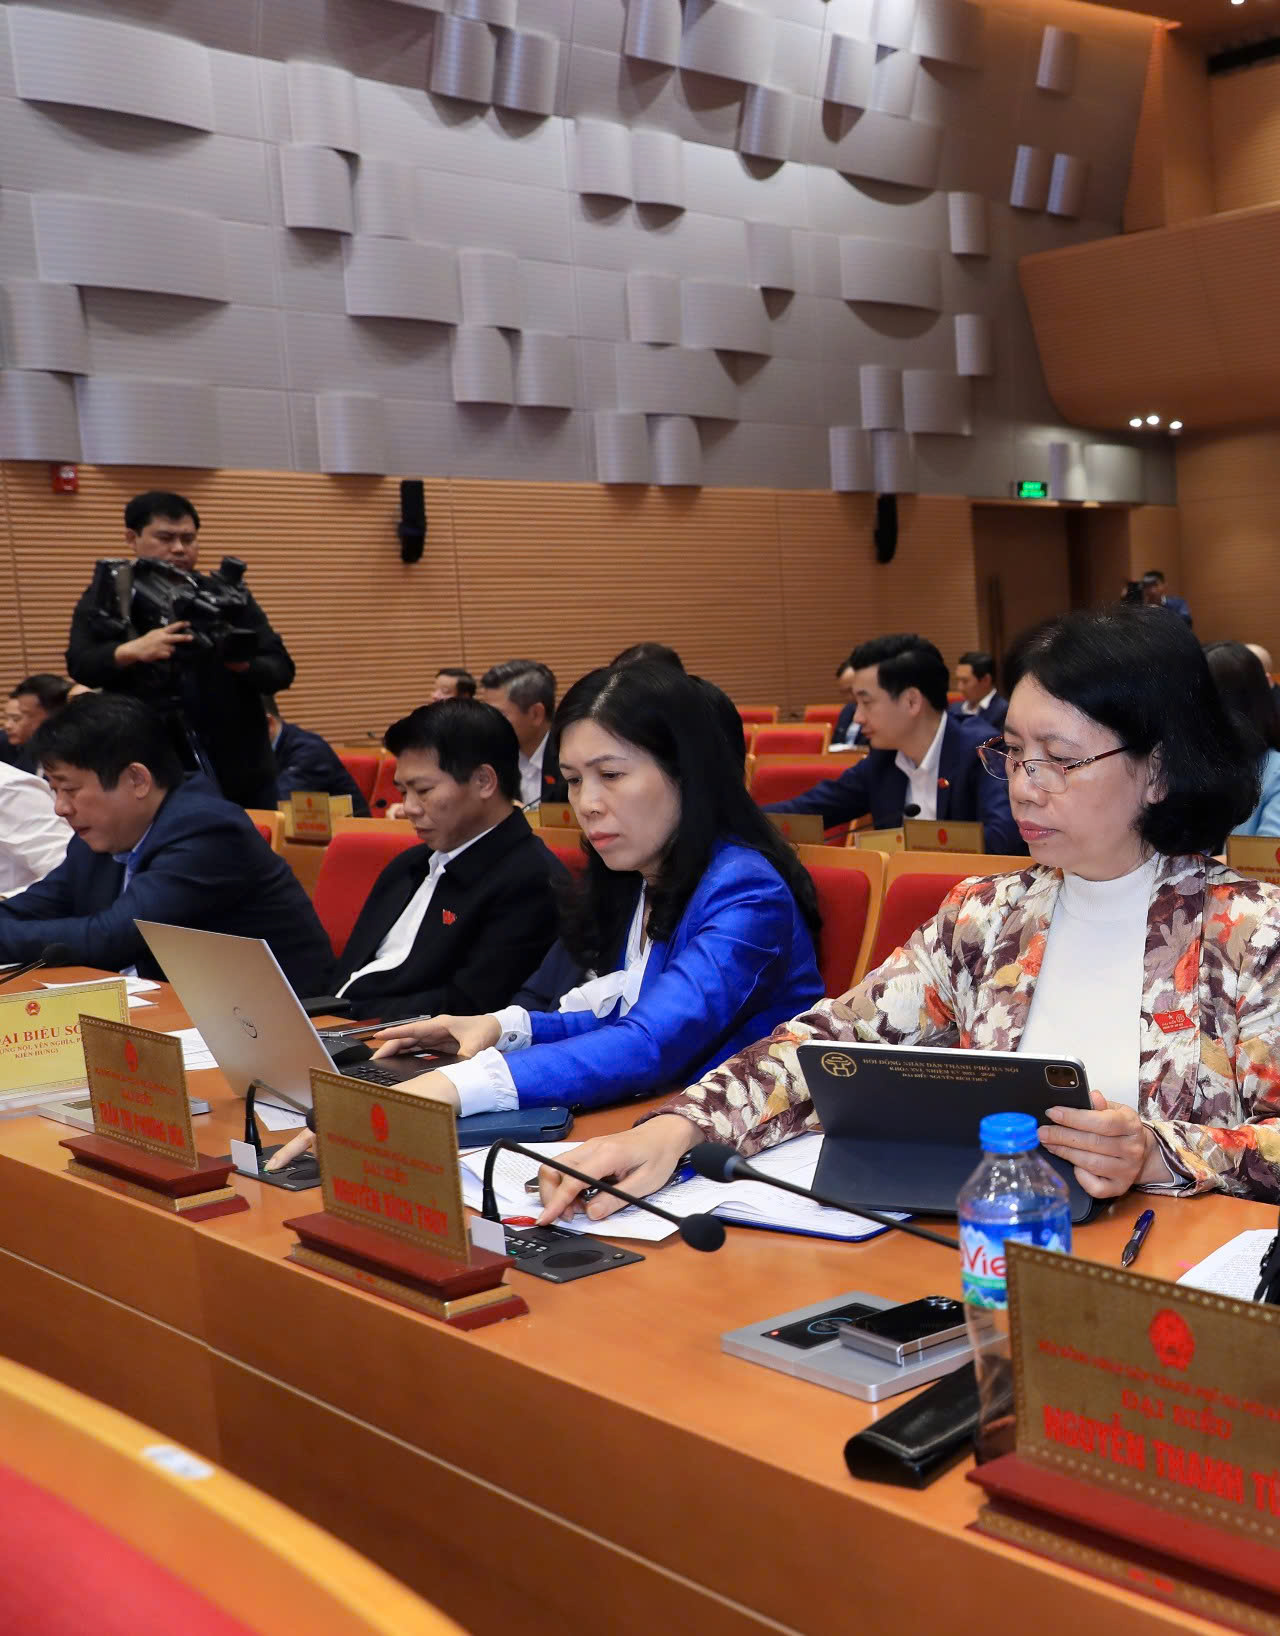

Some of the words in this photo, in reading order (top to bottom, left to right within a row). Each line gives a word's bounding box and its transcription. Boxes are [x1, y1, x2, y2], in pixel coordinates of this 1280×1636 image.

[0, 1032, 19, 1048] ẠI
[22, 1025, 60, 1042] BIỂU
[960, 1241, 1007, 1278] Vie
[1042, 1403, 1146, 1473] NGUYỄN
[1152, 1439, 1245, 1505] THANH
